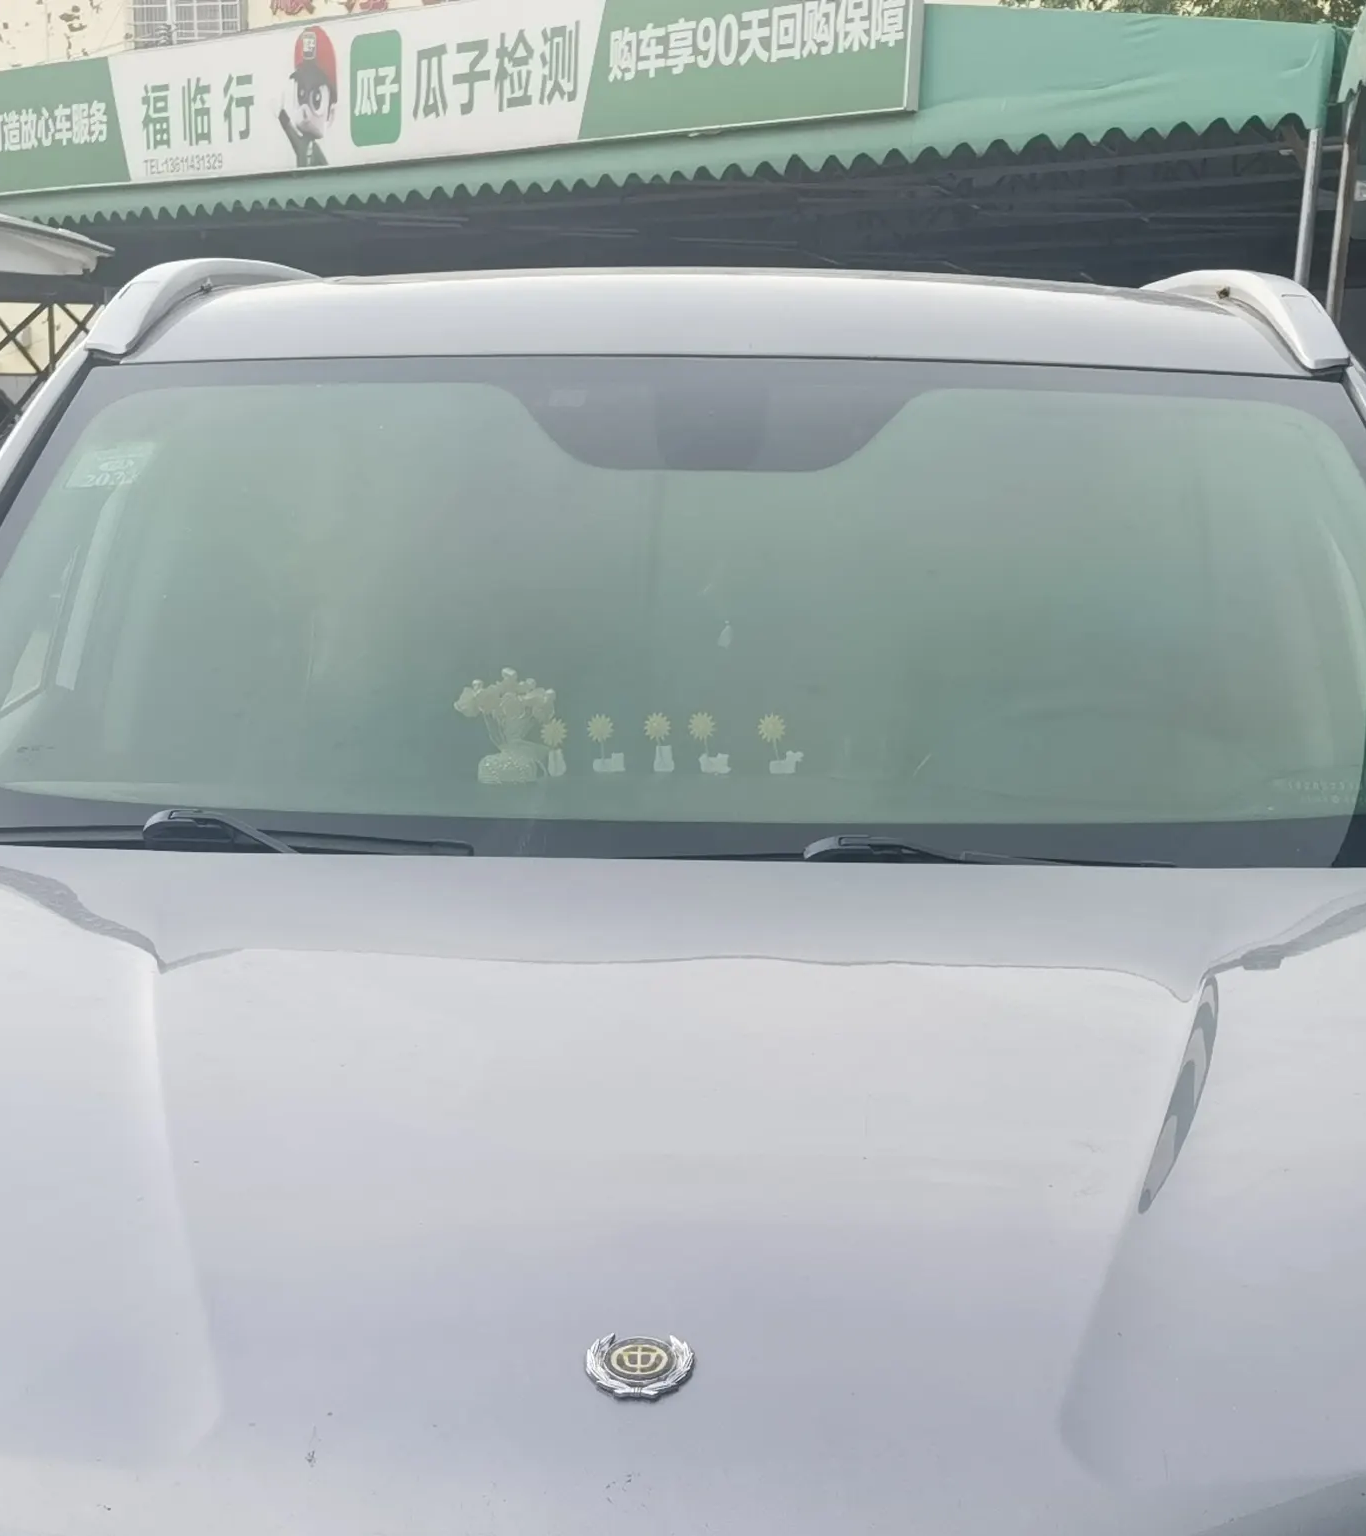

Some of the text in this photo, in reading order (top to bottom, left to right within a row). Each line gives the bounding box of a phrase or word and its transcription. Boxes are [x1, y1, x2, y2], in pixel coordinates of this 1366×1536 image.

[412, 20, 580, 121] 瓜子检测
[608, 0, 904, 82] 购车享90天回购保障
[142, 74, 254, 150] 福临行
[354, 66, 399, 117] 瓜子
